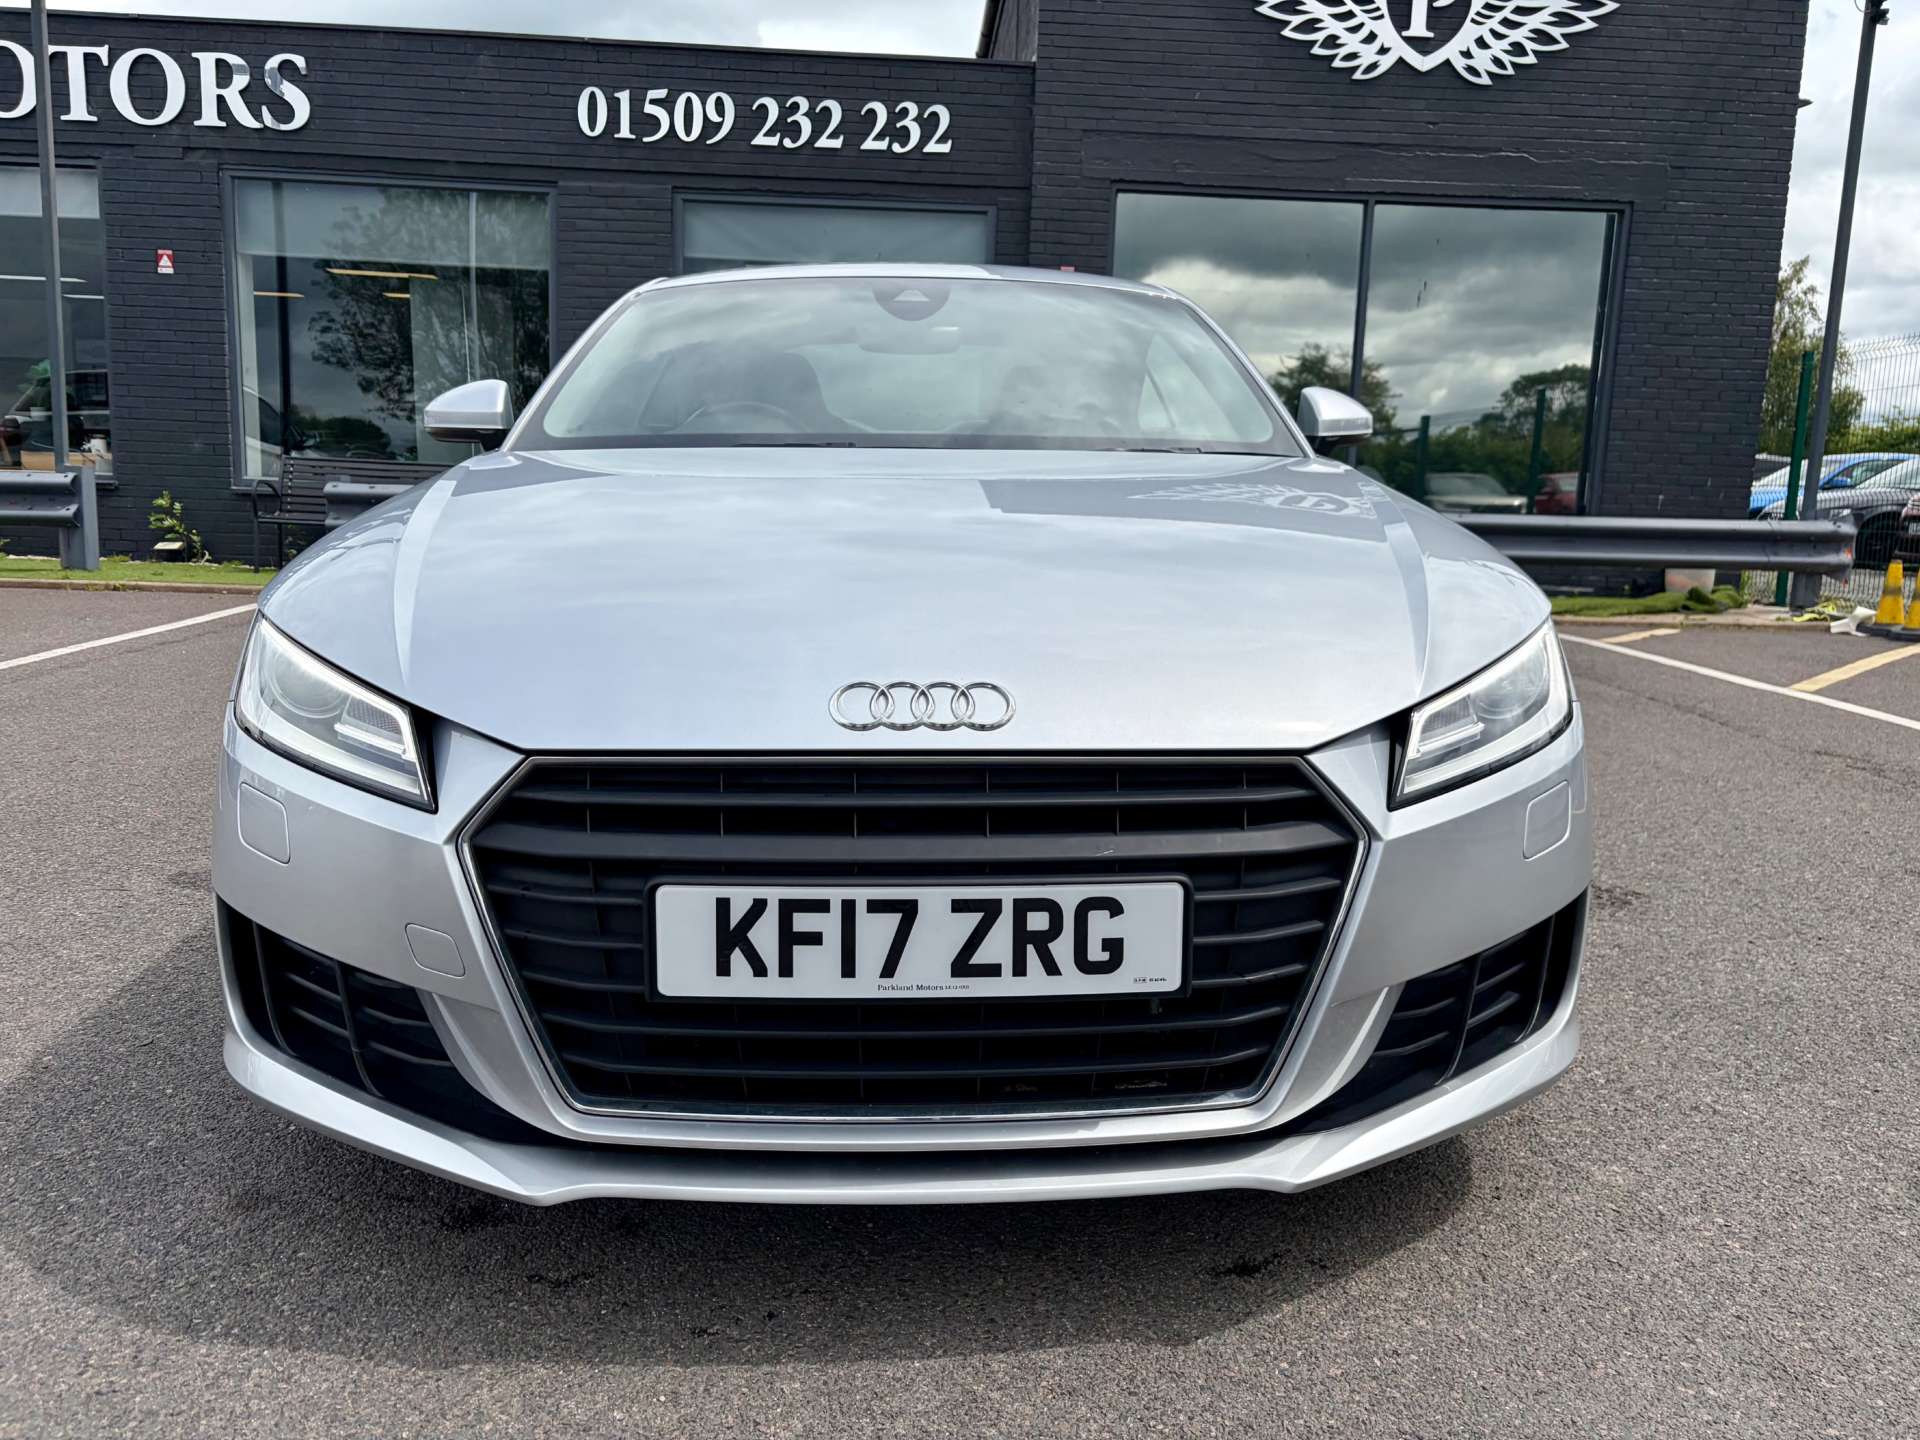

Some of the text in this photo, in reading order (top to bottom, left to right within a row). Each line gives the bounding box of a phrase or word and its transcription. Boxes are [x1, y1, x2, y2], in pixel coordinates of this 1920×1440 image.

[577, 86, 953, 154] 01509 232 232
[715, 896, 1125, 979] KF17 ZRG
[877, 983, 913, 992] Parkland
[915, 983, 944, 992] Motors
